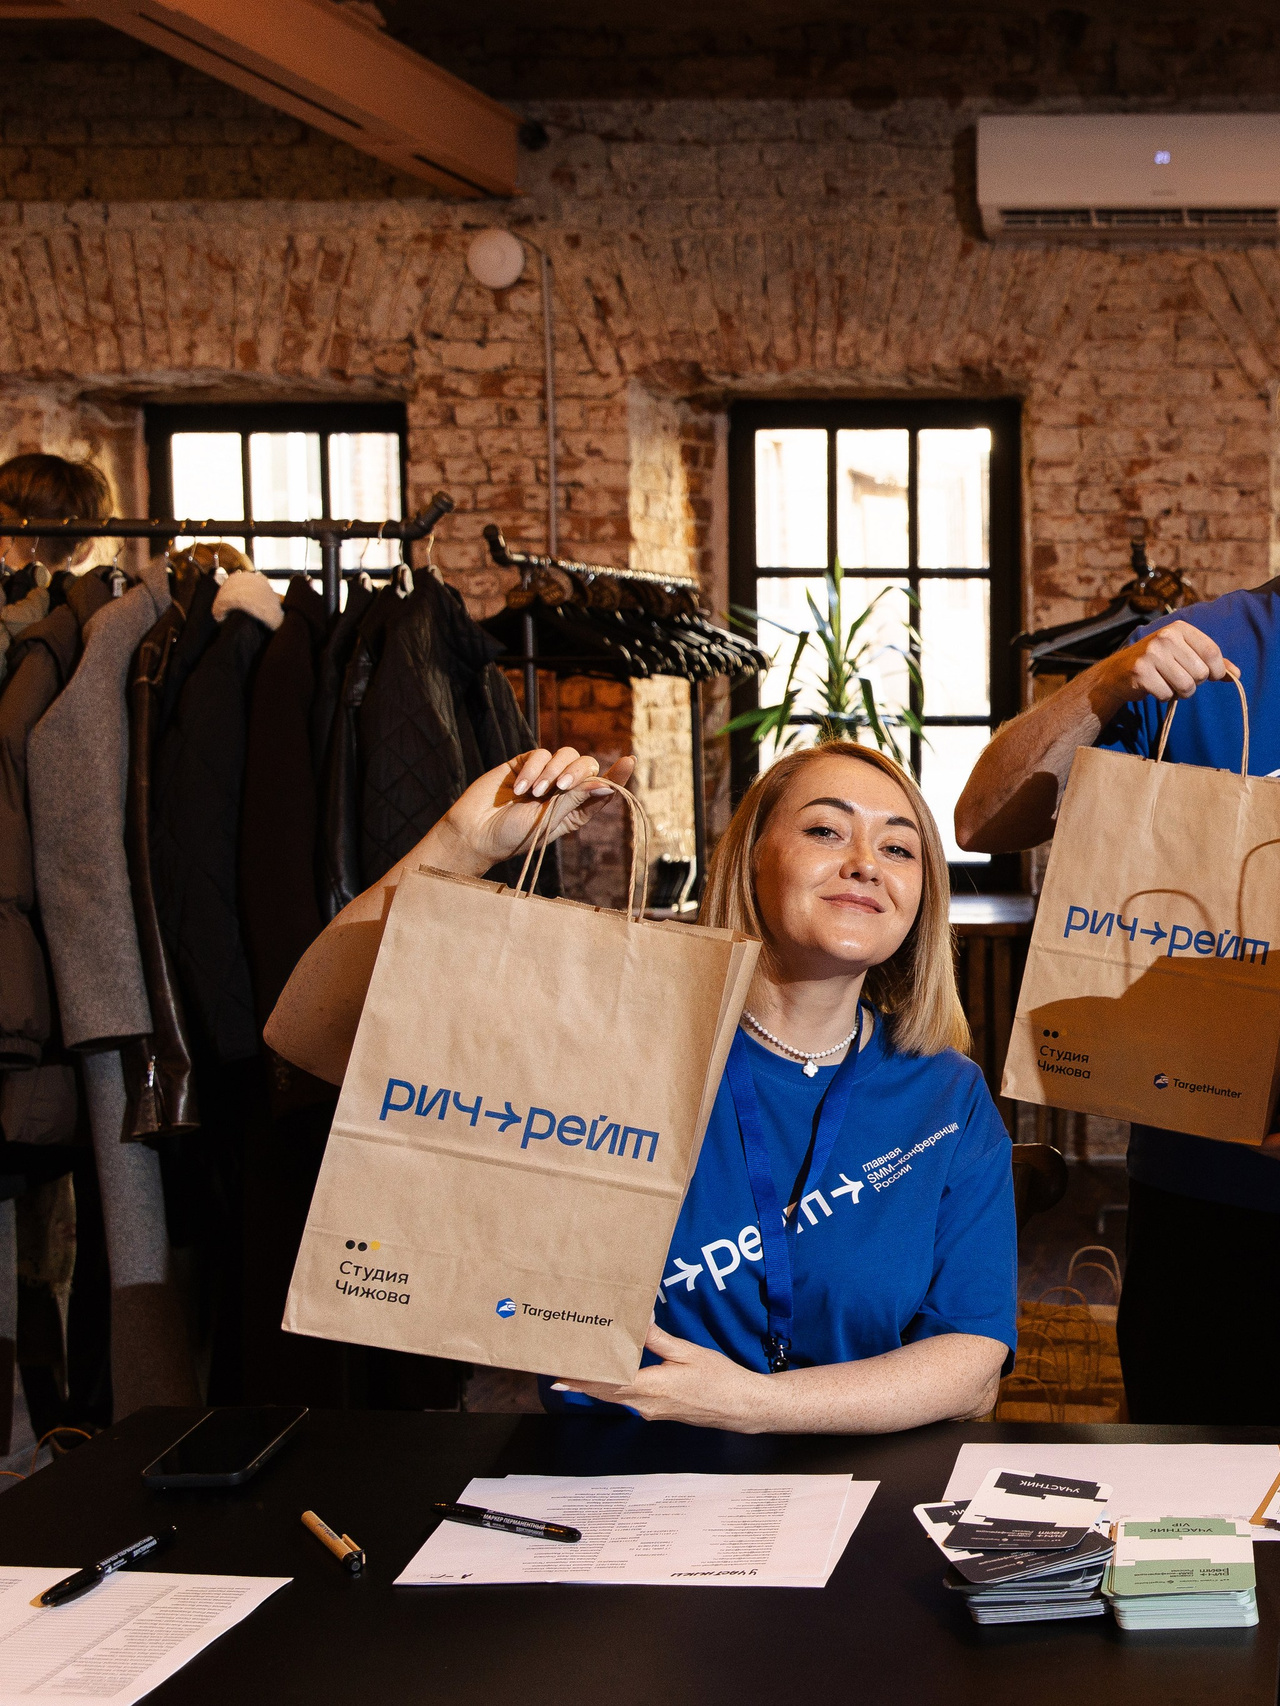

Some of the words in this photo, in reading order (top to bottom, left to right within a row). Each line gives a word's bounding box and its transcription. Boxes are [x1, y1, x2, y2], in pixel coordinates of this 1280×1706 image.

[1039, 1045, 1090, 1064] Студия
[1037, 1059, 1091, 1079] Чижова
[1173, 1078, 1243, 1099] TargetHunter
[862, 1147, 903, 1173] главная
[873, 1164, 913, 1193] России
[339, 1260, 409, 1286] Студия
[335, 1279, 411, 1306] Чижова
[521, 1302, 614, 1328] TargetHunter
[1019, 1479, 1081, 1494] УЧАСТНИК
